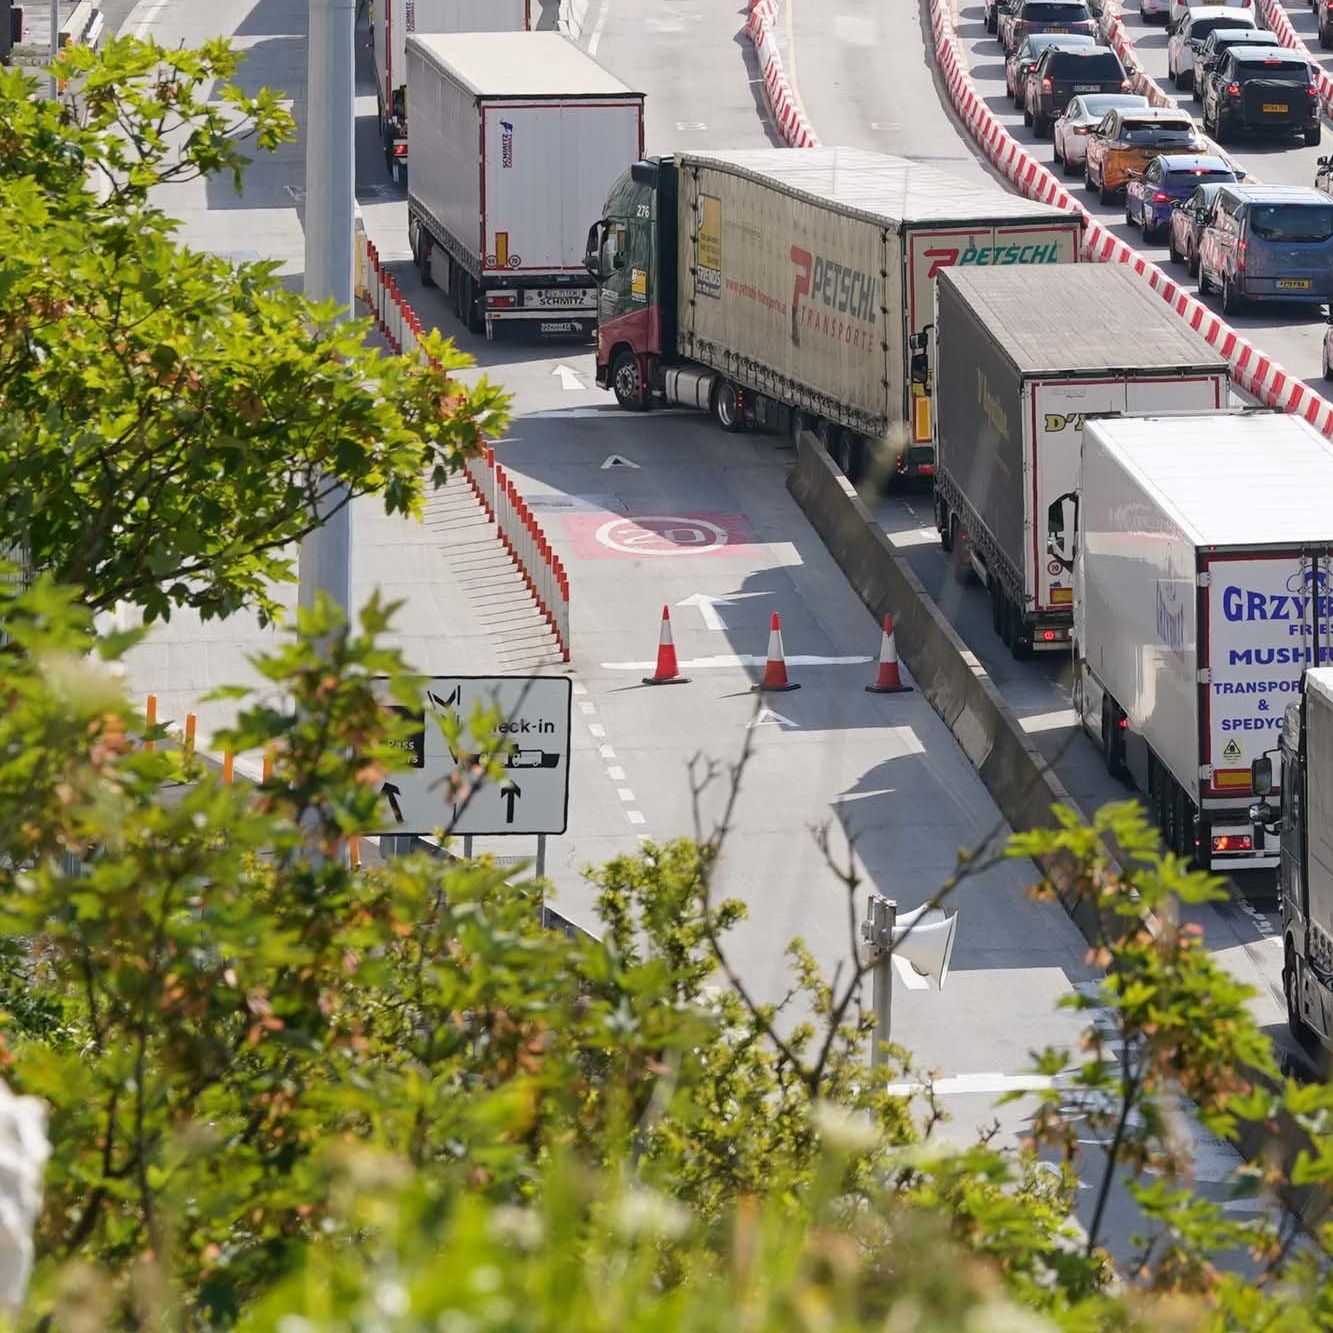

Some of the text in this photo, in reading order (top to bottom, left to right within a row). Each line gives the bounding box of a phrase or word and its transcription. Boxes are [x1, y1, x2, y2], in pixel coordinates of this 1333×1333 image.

[637, 204, 650, 218] 276
[959, 243, 1058, 266] PETSCHL
[812, 256, 877, 325] PETSCHL
[540, 297, 584, 305] SCHMITZ
[801, 305, 875, 354] TRANSPORTE
[1258, 699, 1269, 711] &
[492, 719, 554, 734] eck-in
